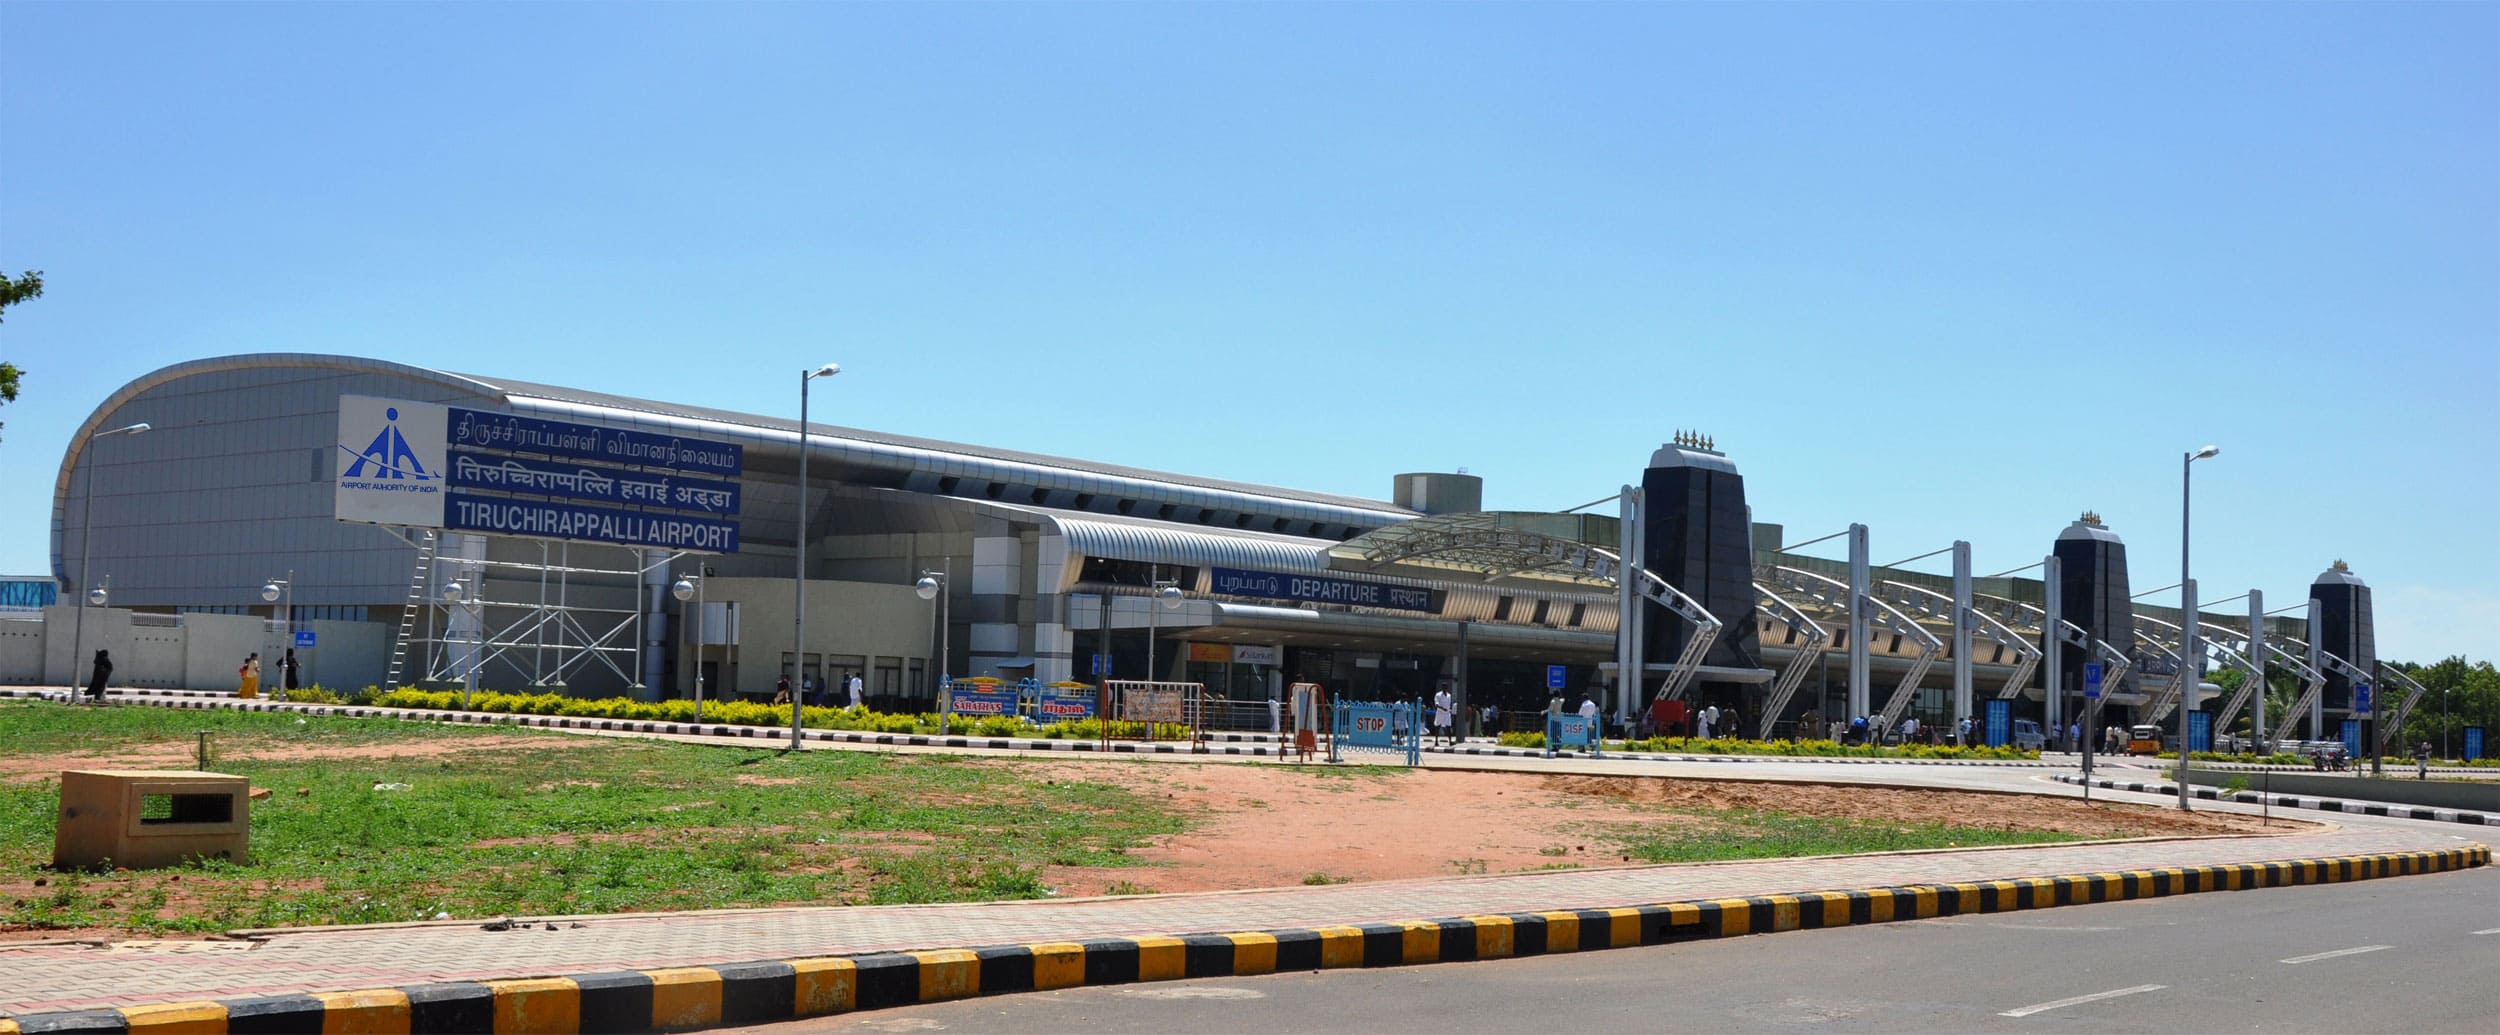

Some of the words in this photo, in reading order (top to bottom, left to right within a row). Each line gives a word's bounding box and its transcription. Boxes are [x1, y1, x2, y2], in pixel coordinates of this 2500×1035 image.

[457, 412, 600, 453] திருச்சிராப்பள்ளி
[607, 432, 735, 468] விமானநிலையம்
[341, 481, 371, 490] AIRPORT
[620, 478, 669, 504] हवाई
[457, 501, 643, 541] TIRUCHIRAPPALLI
[647, 520, 733, 549] AIRPORT
[1219, 572, 1279, 595] புறப்பாடு
[1291, 578, 1379, 602] DEPARTURE
[1390, 587, 1428, 607] प्रस्थान
[1357, 717, 1385, 731] STOP
